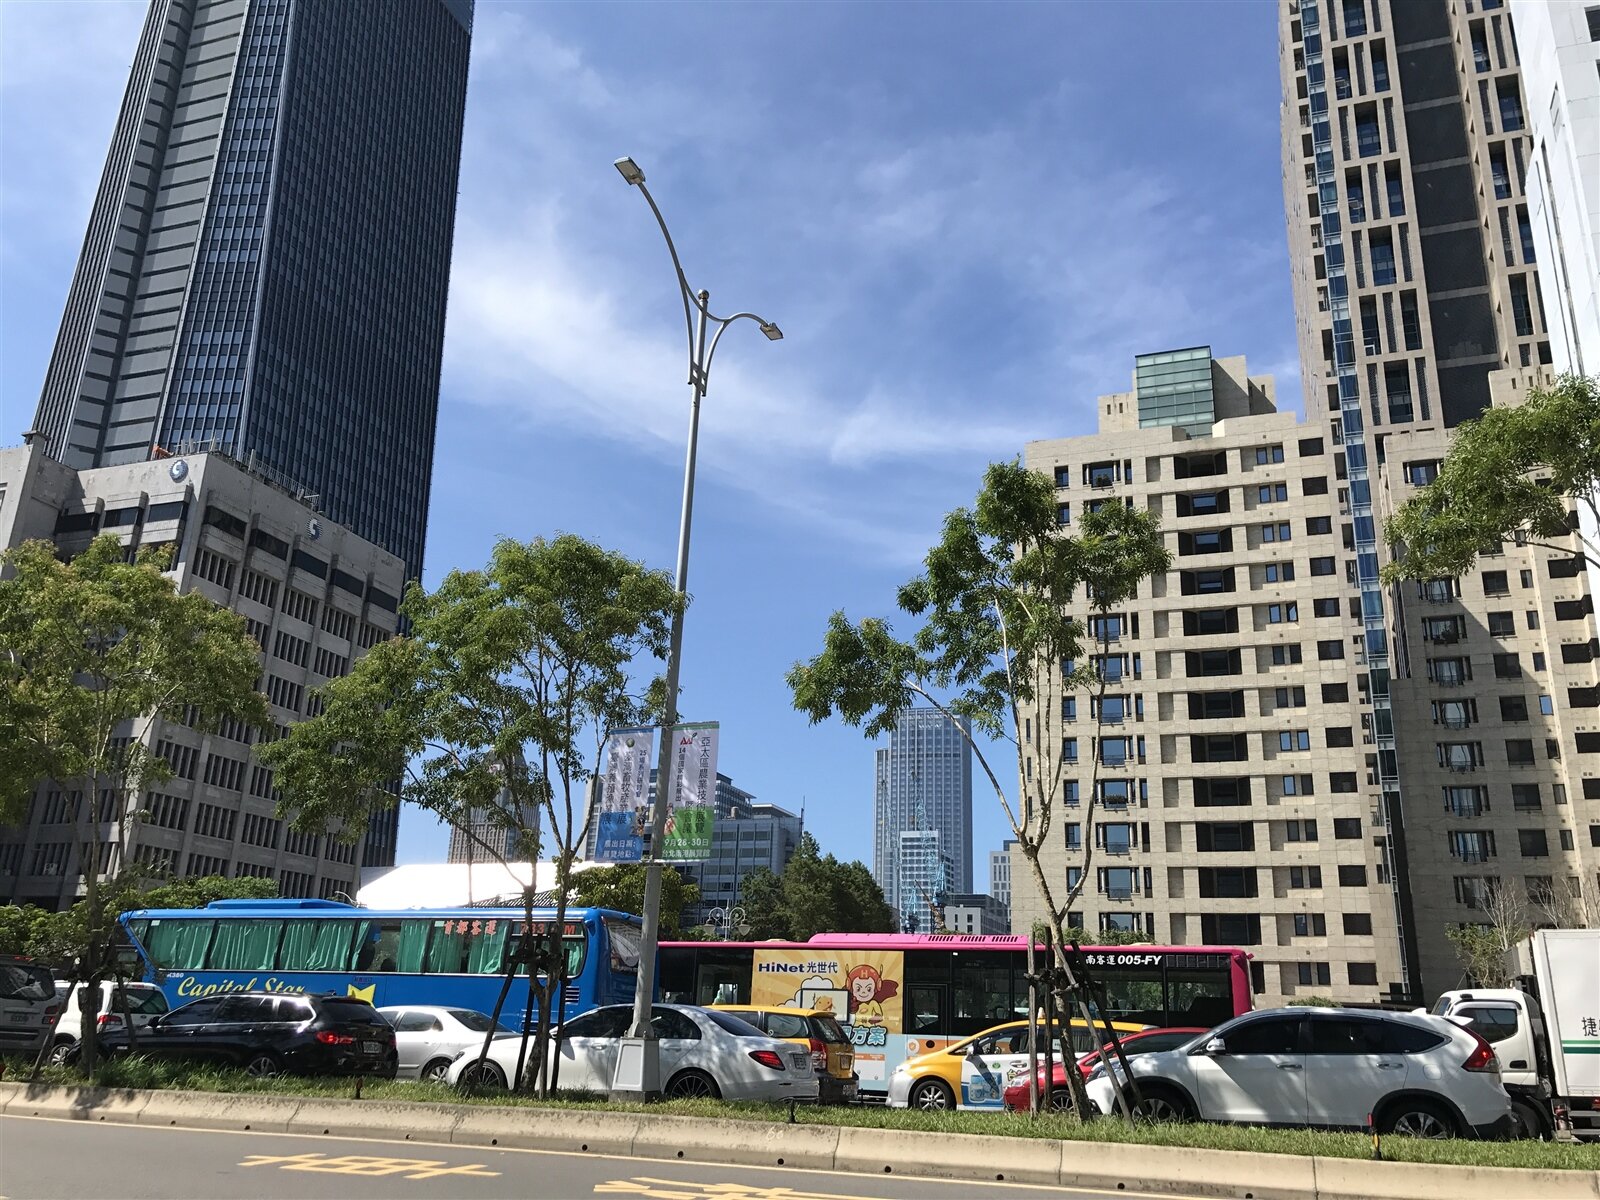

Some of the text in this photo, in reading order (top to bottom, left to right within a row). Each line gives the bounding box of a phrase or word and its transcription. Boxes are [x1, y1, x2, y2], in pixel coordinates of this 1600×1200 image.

[695, 735, 711, 834] 亞太區農業技術展覽
[444, 919, 497, 935] 首都客運
[758, 961, 838, 974] HiNet 光世代
[1117, 954, 1162, 966] 005-FY
[177, 976, 306, 997] Capital Star
[1581, 1016, 1600, 1037] 捷
